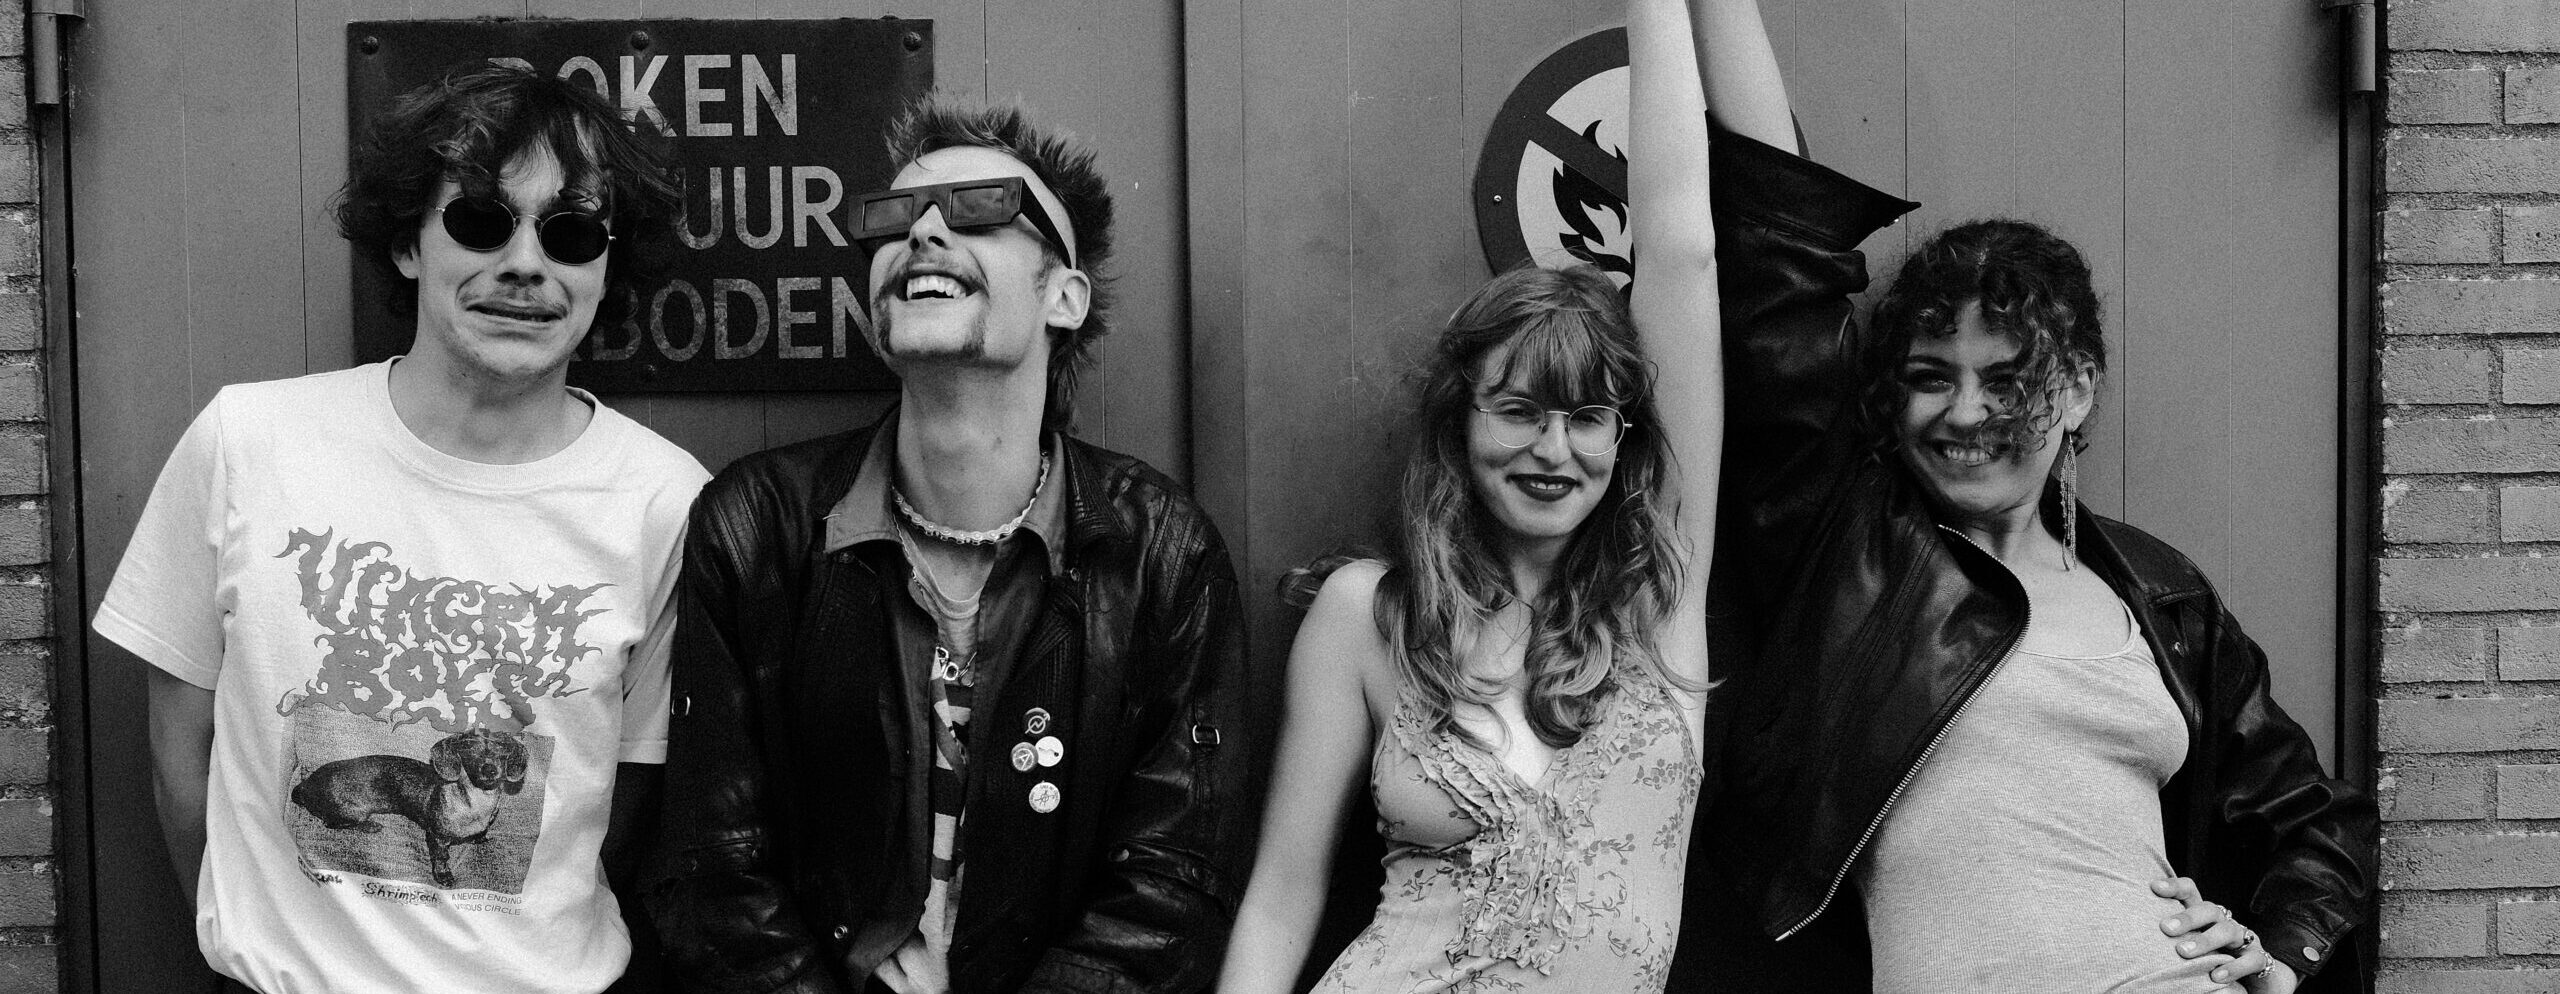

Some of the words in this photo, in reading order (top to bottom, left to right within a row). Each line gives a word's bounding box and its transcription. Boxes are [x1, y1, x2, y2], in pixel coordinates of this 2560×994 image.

[658, 166, 848, 250] UUR
[273, 525, 617, 670] VIAGRA
[457, 892, 485, 901] NEVER
[487, 893, 522, 905] ENDING
[484, 904, 522, 916] CIRCLE
